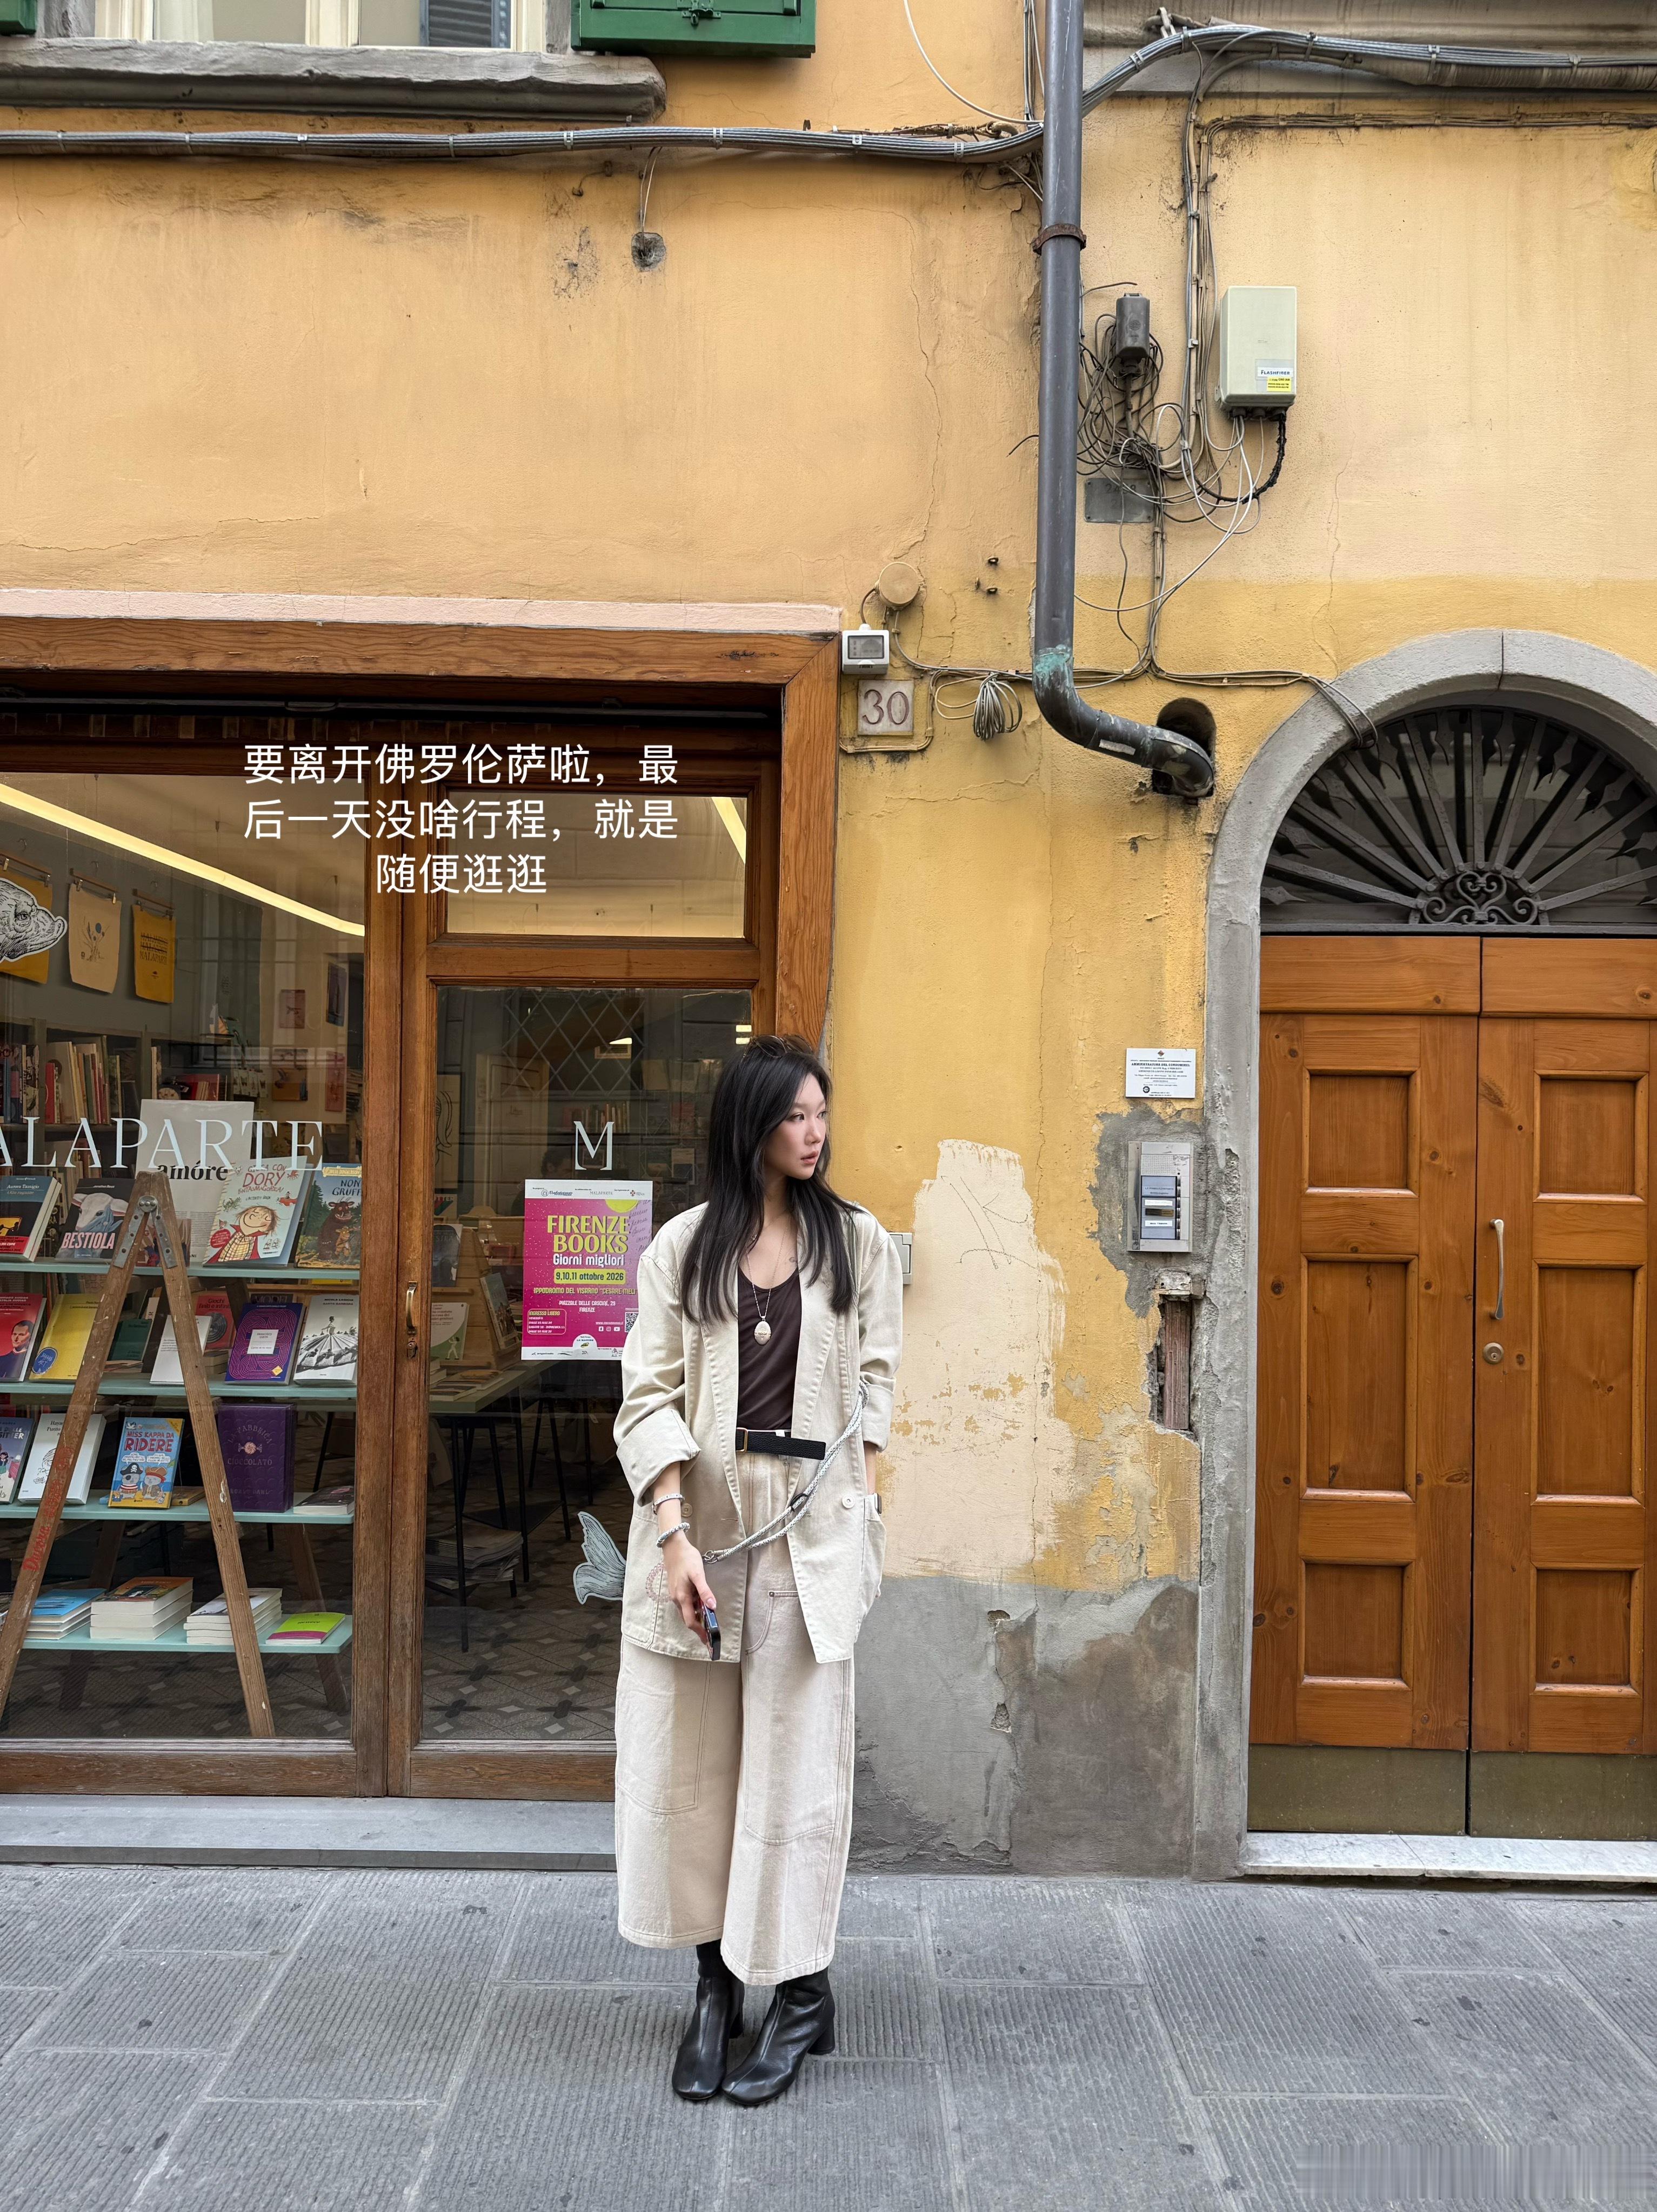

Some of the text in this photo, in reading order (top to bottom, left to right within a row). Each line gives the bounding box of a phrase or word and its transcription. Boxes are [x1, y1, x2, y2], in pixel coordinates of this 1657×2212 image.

[863, 689, 910, 725] 30
[573, 1121, 614, 1170] M
[243, 1171, 286, 1187] DORY
[547, 1215, 631, 1235] FIRENZE
[61, 1232, 116, 1249] BESTIOLA
[553, 1234, 629, 1254] BOOKS
[553, 1254, 625, 1268] Giorni migliori
[556, 1272, 624, 1281] 9,10,11 ottobre 2026
[237, 1424, 273, 1444] FABBRICA
[124, 1438, 174, 1452] RIDERE
